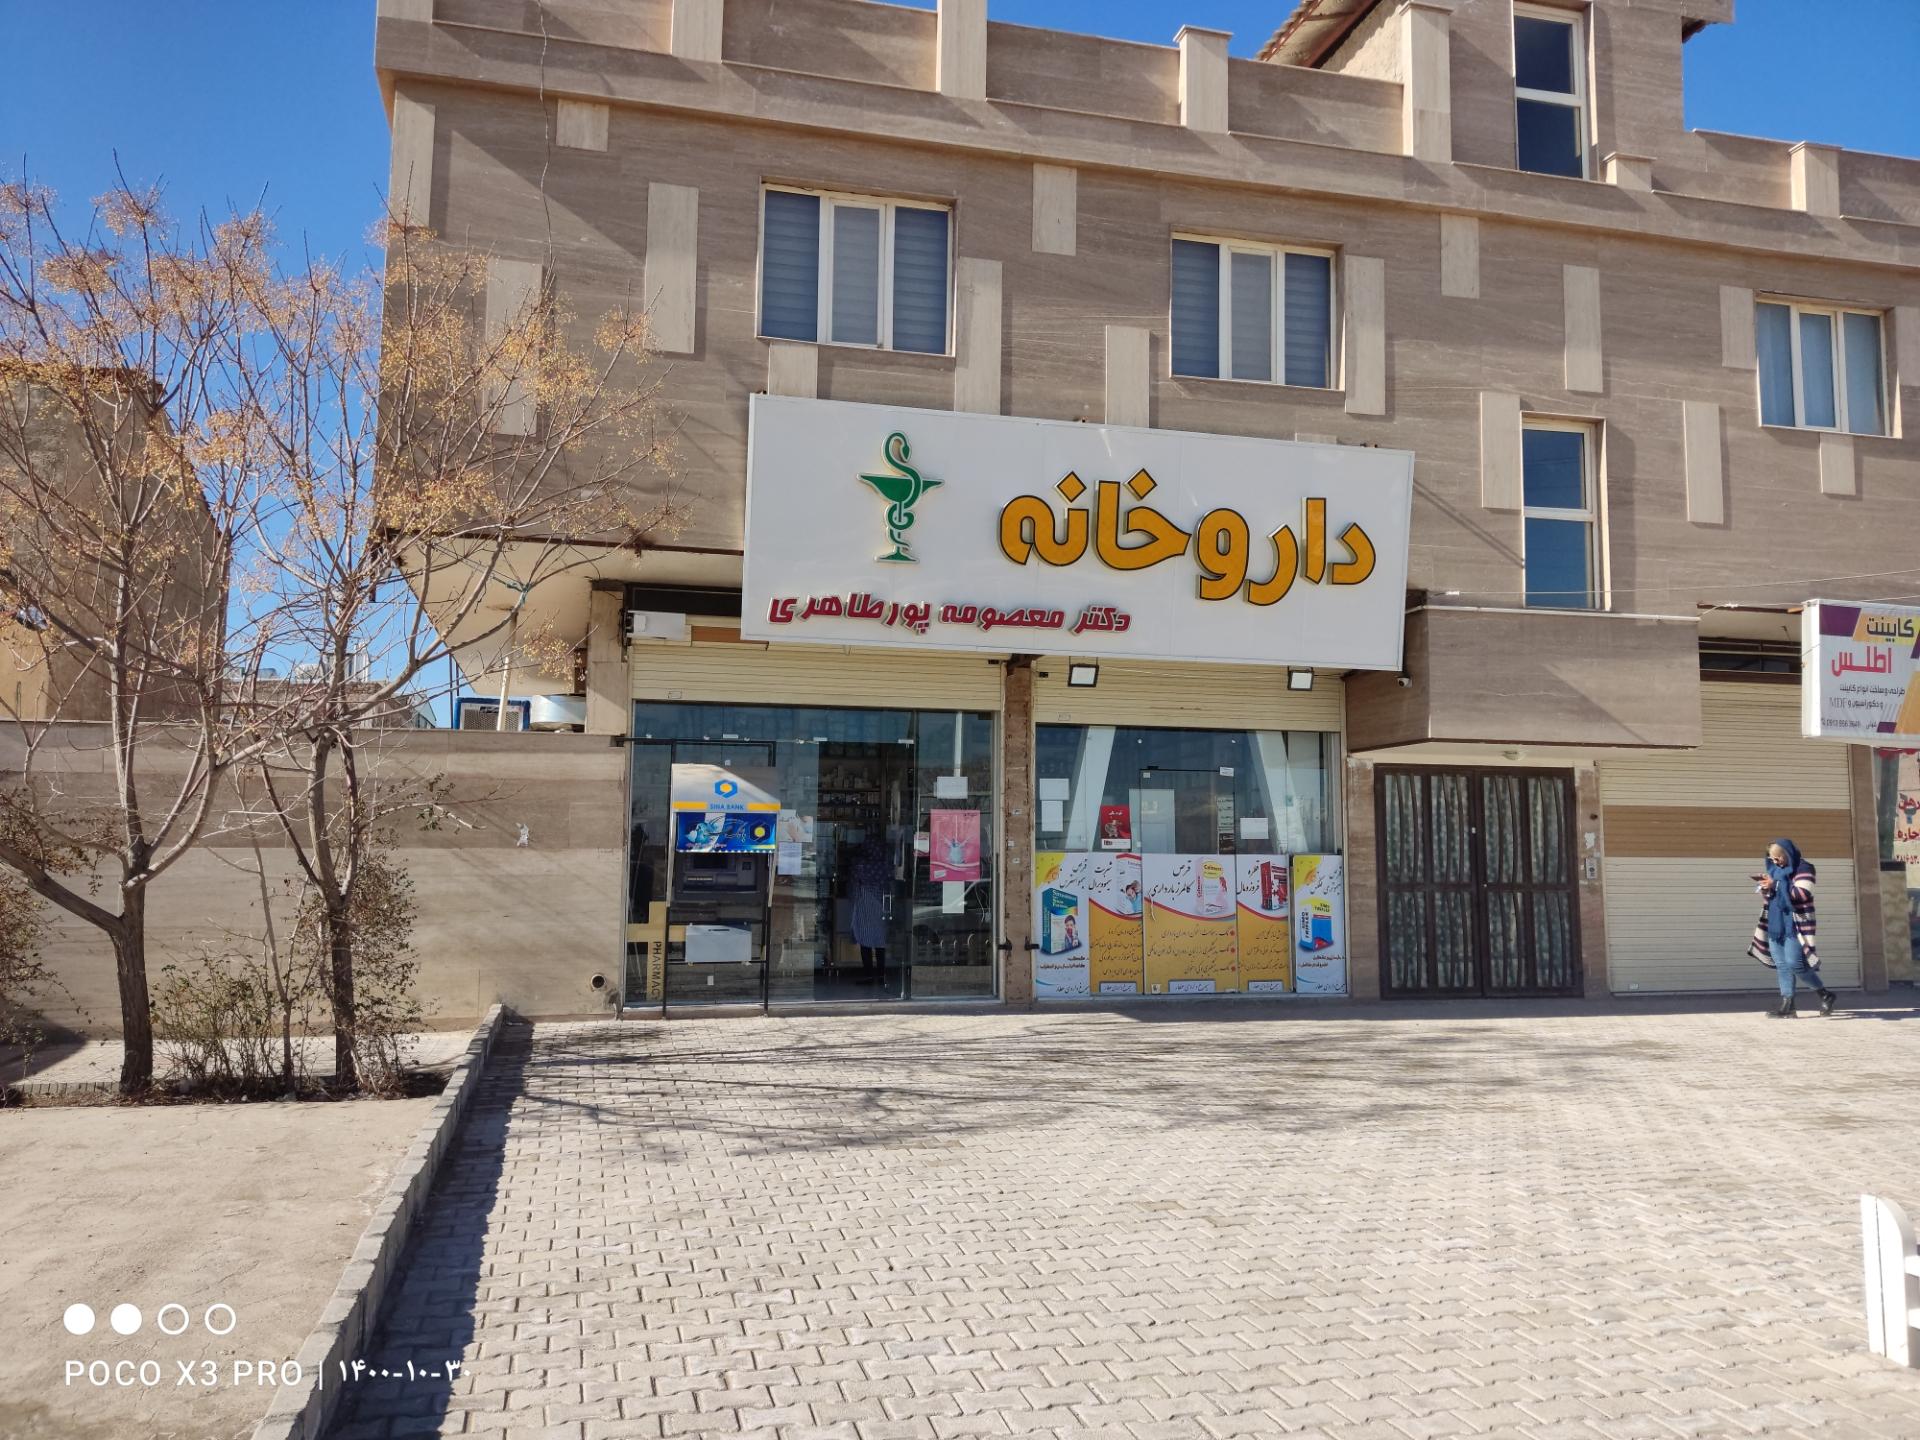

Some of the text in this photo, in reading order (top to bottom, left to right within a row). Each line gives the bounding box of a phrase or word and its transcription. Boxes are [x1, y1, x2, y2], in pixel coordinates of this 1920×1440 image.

[998, 467, 1376, 606] داروخانه
[938, 602, 1066, 631] معصومه
[1071, 604, 1132, 635] دکتر
[1867, 617, 1914, 643] کابینت
[1831, 645, 1892, 677] اطلس
[710, 803, 745, 811] SINA BANK
[1172, 859, 1192, 878] قرص
[651, 941, 662, 999] PHARMAC
